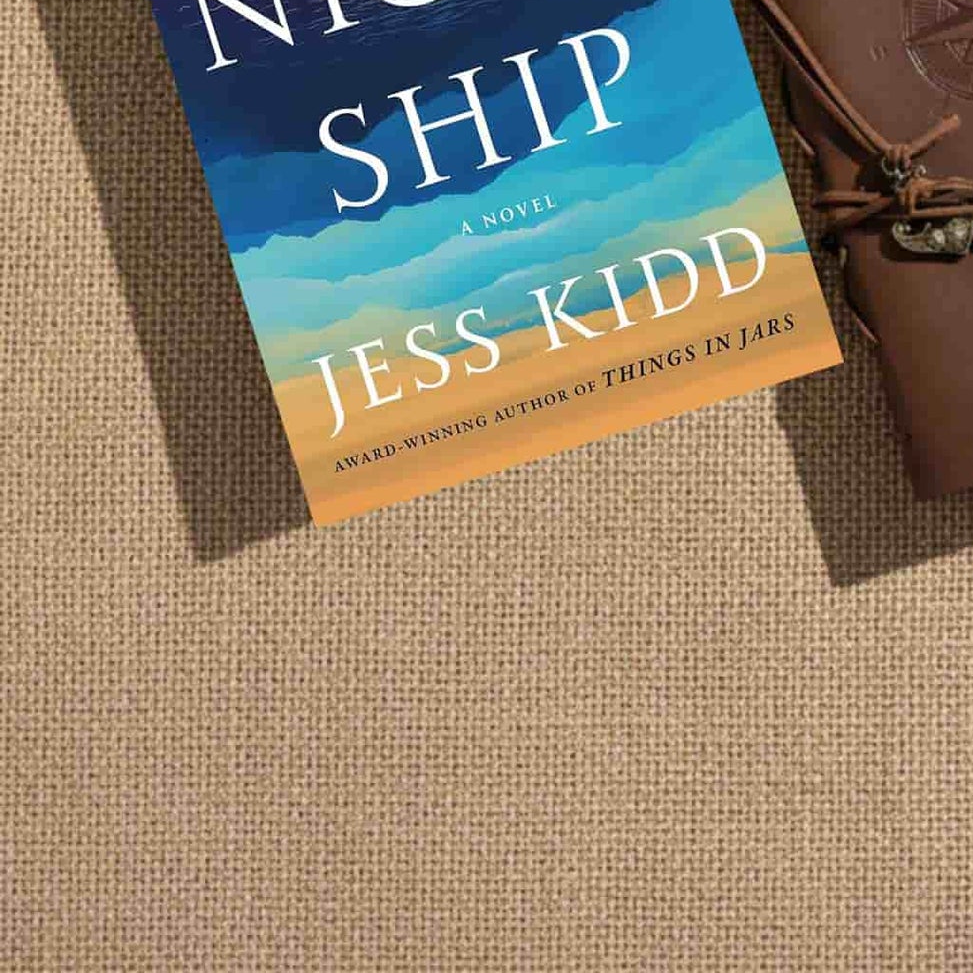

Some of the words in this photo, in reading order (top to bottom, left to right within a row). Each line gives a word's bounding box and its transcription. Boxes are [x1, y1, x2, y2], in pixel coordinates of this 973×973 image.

[318, 27, 631, 214] SHIP
[460, 220, 473, 236] A
[482, 193, 557, 229] NOVEL
[311, 305, 501, 439] JESS
[528, 227, 767, 352] KIDD
[334, 415, 488, 473] AWARD-WINNING
[494, 389, 570, 423] AUTHOR
[574, 380, 597, 396] OF
[602, 344, 697, 389] THINGS
[704, 332, 732, 355] IN
[739, 313, 796, 350] JARS
